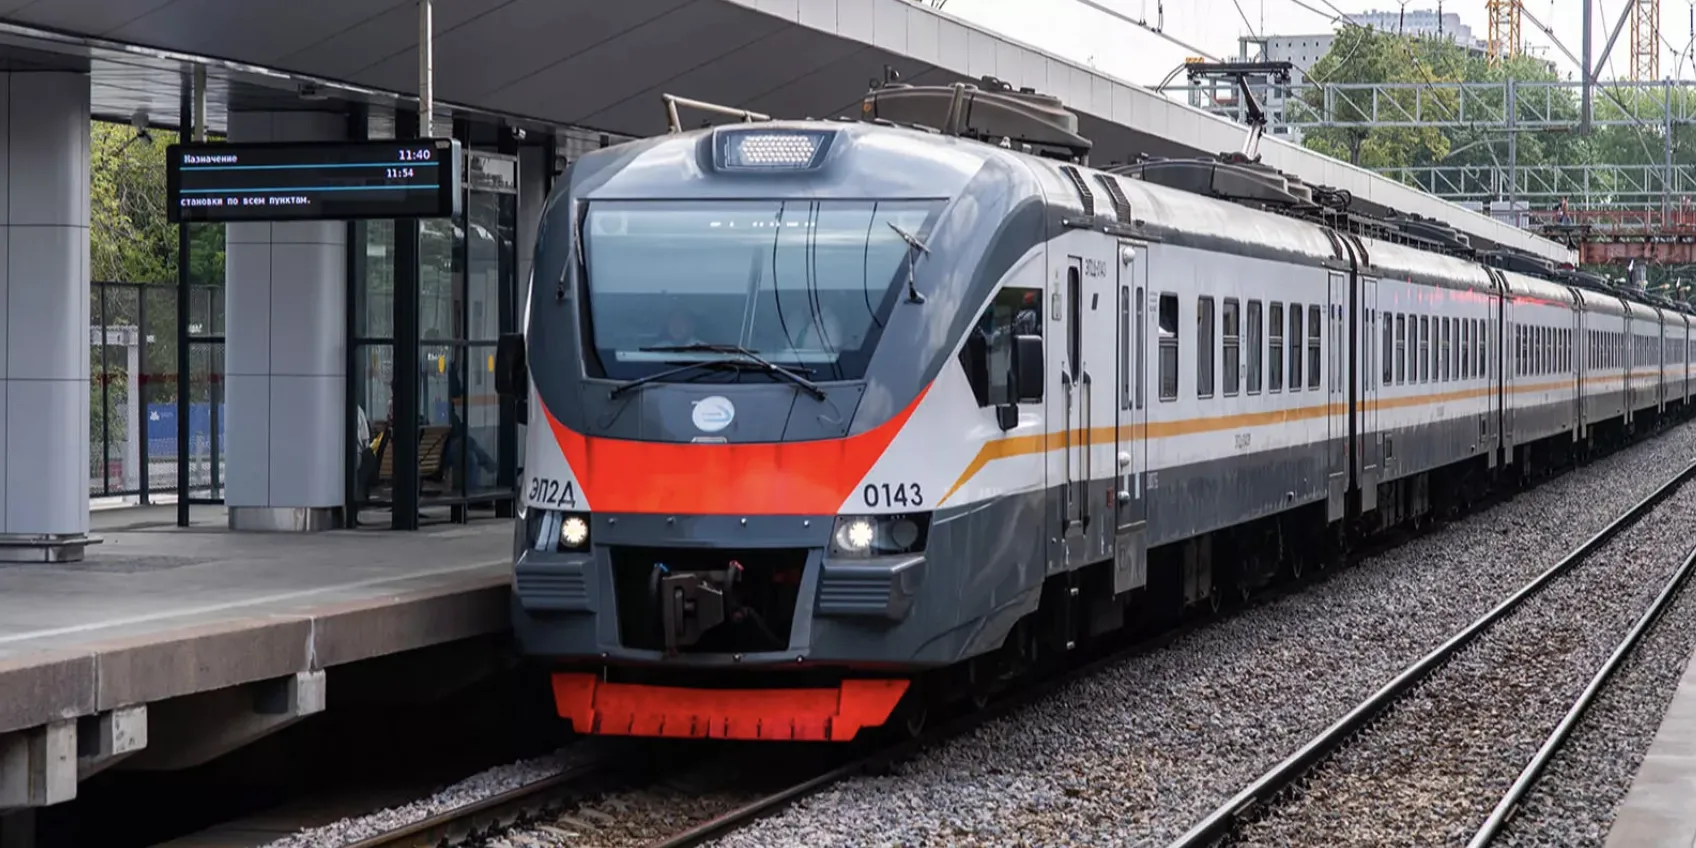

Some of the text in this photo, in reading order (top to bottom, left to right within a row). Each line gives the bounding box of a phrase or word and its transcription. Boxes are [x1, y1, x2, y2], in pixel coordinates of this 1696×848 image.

[183, 154, 238, 164] Назначение
[398, 149, 431, 160] 11:40
[386, 168, 414, 178] 11:54
[180, 196, 311, 206] становки по всем пунктам.
[529, 477, 577, 509] ЭП2Д
[863, 482, 924, 508] 0143
